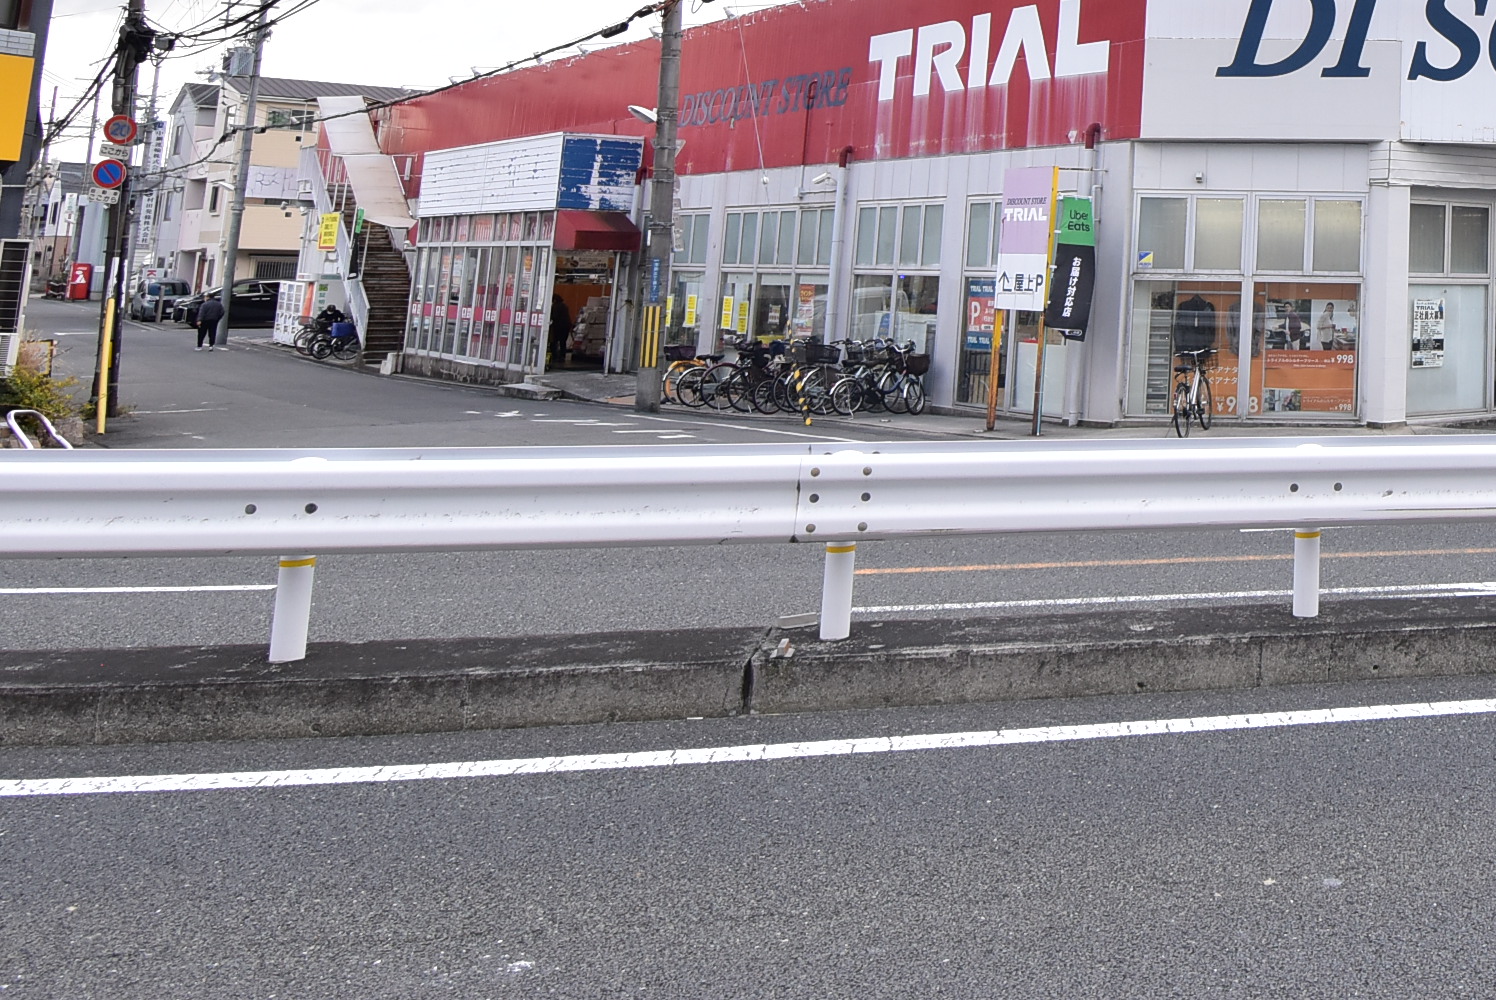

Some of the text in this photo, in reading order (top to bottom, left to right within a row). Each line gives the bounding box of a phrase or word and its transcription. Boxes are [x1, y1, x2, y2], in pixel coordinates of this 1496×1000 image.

[677, 67, 853, 128] DISCOUNT STORE
[110, 122, 131, 137] 20
[100, 146, 129, 158] ここから
[88, 193, 117, 203] ここから
[1006, 196, 1047, 206] DISCOUNT STORE
[1004, 207, 1047, 222] TRIAL
[1069, 209, 1089, 221] Uber
[1067, 221, 1091, 232] Eats
[1062, 256, 1082, 318] お届け対応店
[970, 301, 981, 326] P
